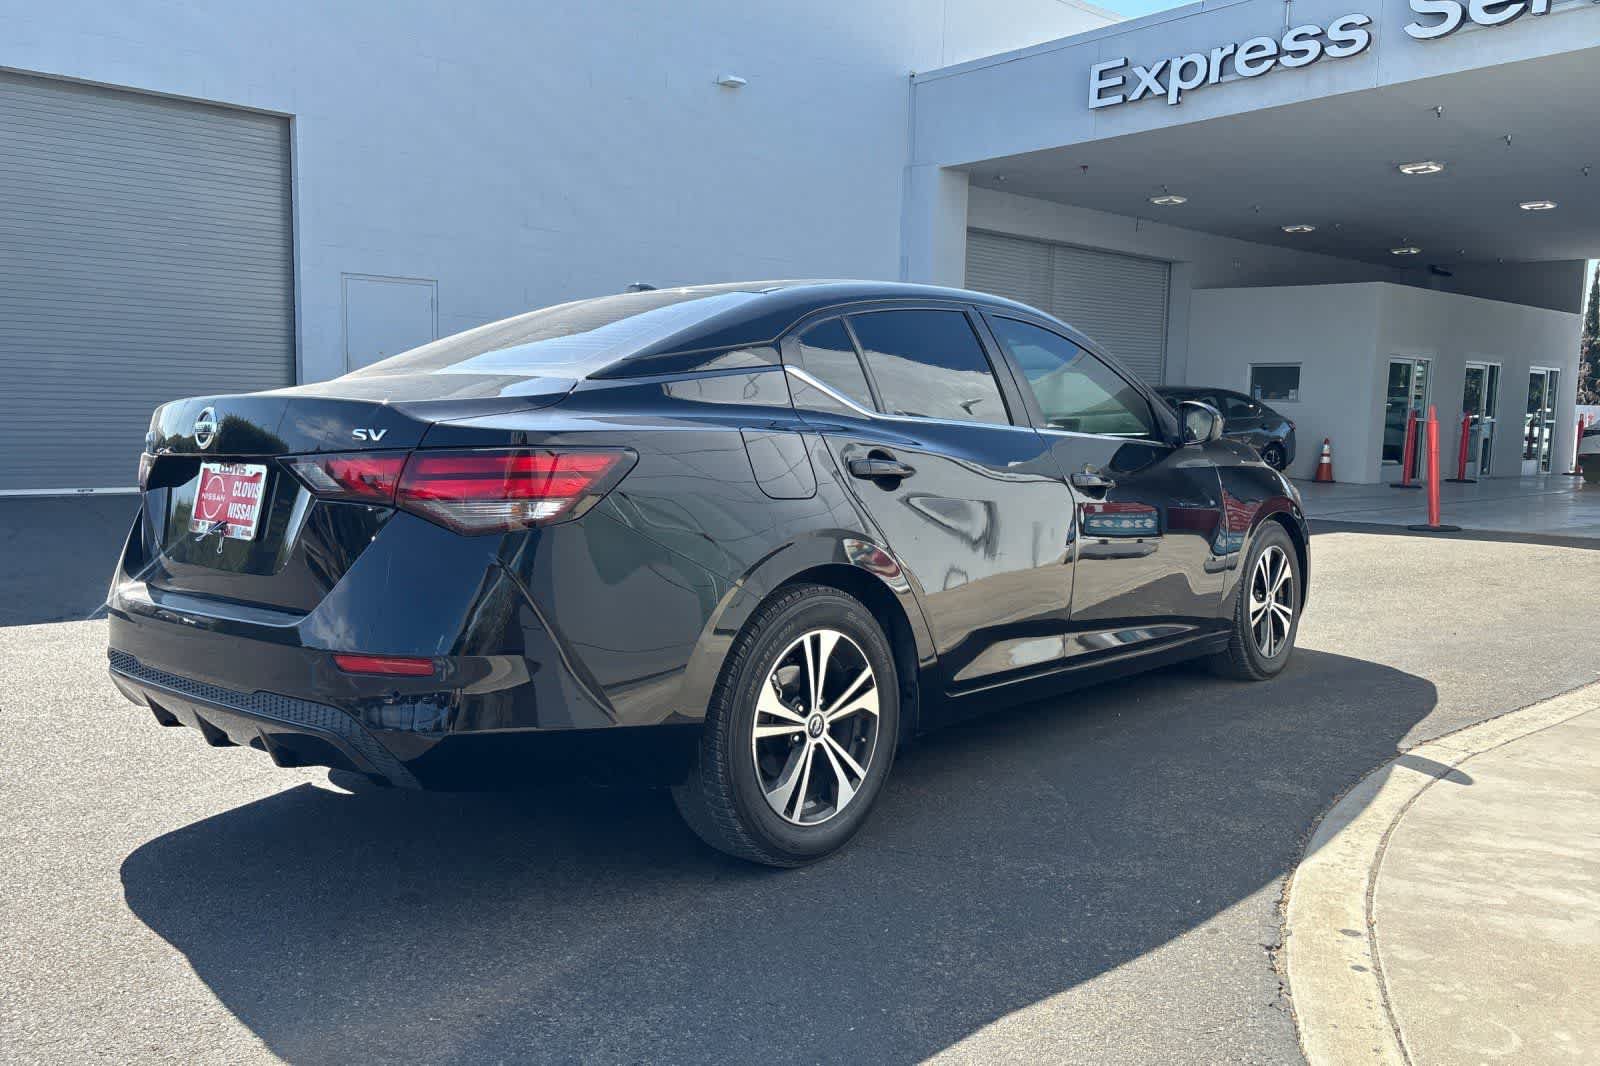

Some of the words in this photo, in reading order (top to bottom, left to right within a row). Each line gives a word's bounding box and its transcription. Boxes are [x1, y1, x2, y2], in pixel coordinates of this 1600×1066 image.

[1088, 13, 1371, 108] Express
[352, 428, 388, 441] SV
[201, 492, 226, 502] NISSAN
[232, 481, 260, 498] CLOVIS
